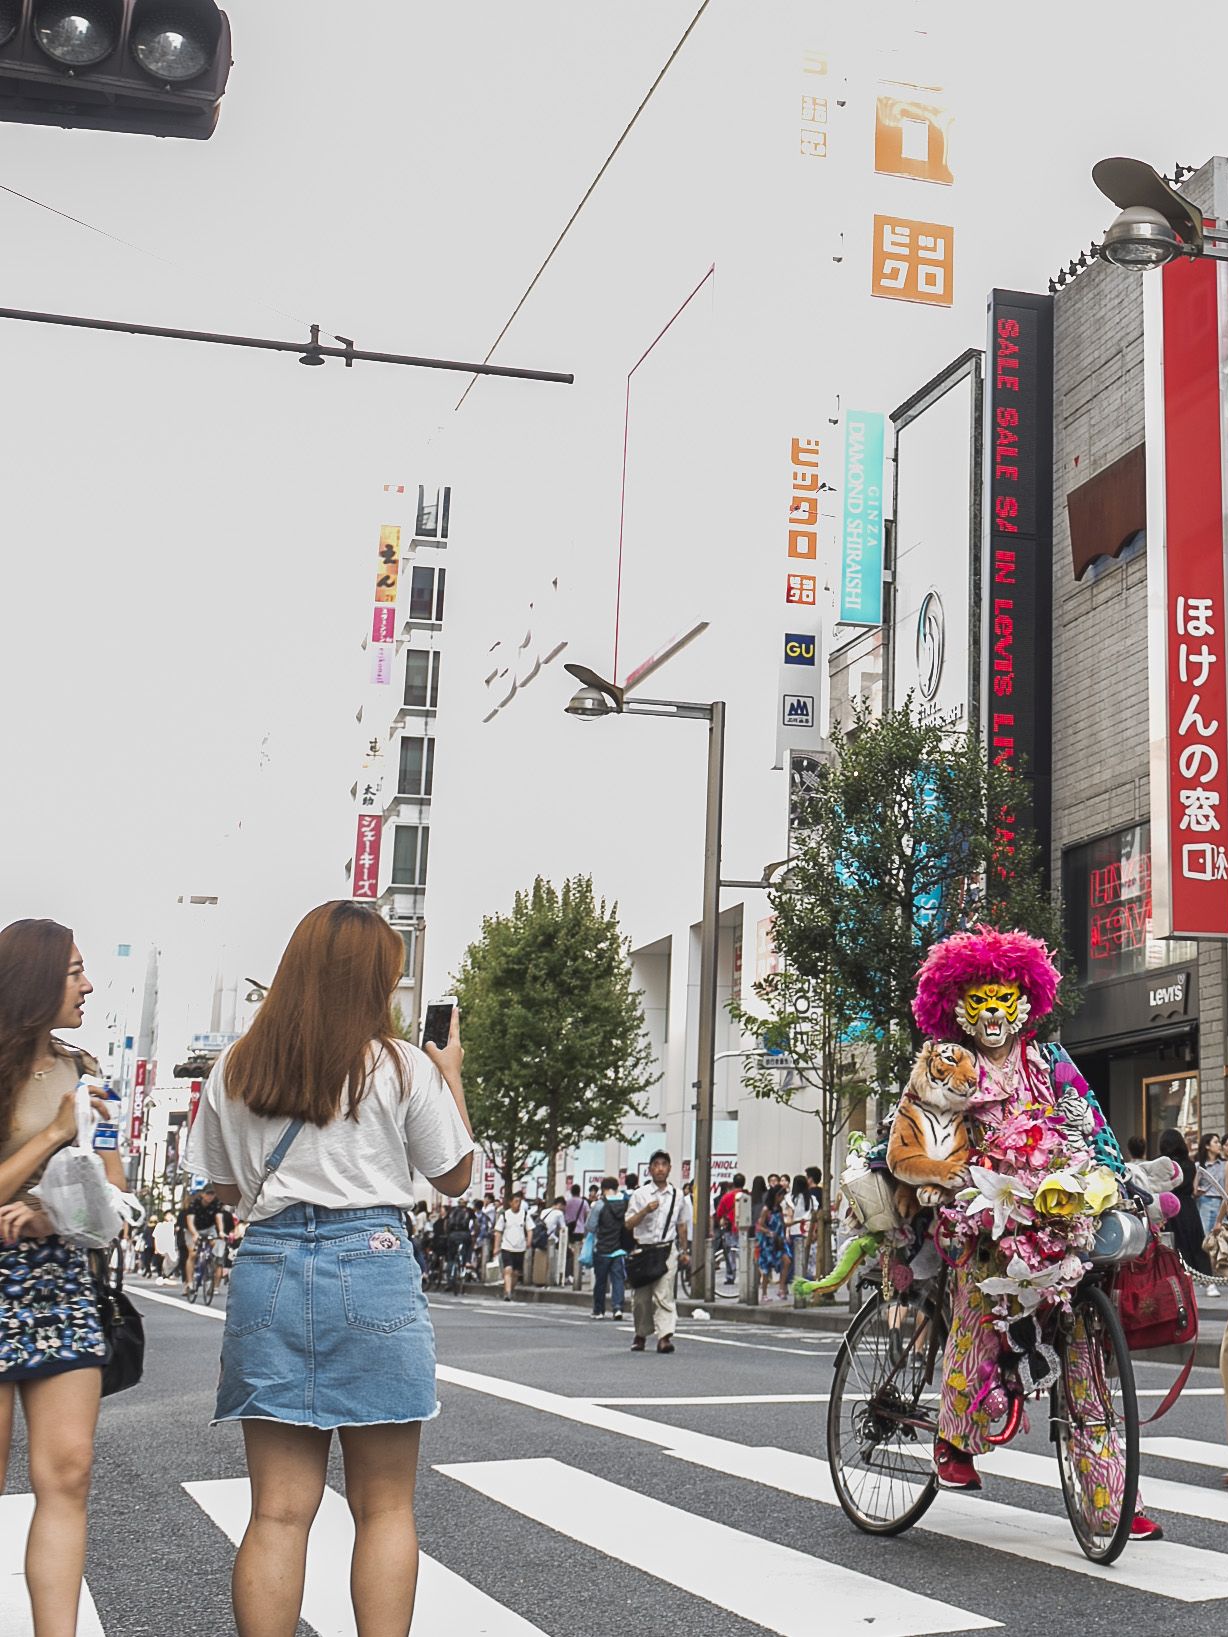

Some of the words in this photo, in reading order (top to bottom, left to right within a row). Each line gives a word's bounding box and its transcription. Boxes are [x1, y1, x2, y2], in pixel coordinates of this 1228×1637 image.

[997, 319, 1020, 391] SALE
[847, 421, 865, 514] DIAMOND
[995, 408, 1019, 481] SALE
[867, 486, 880, 547] GINZA
[846, 519, 864, 610] SHIRAISHI
[995, 551, 1016, 584] IN
[786, 642, 814, 658] GU
[1176, 596, 1224, 881] ほけんの窓口
[356, 816, 377, 897] シェーキーズ
